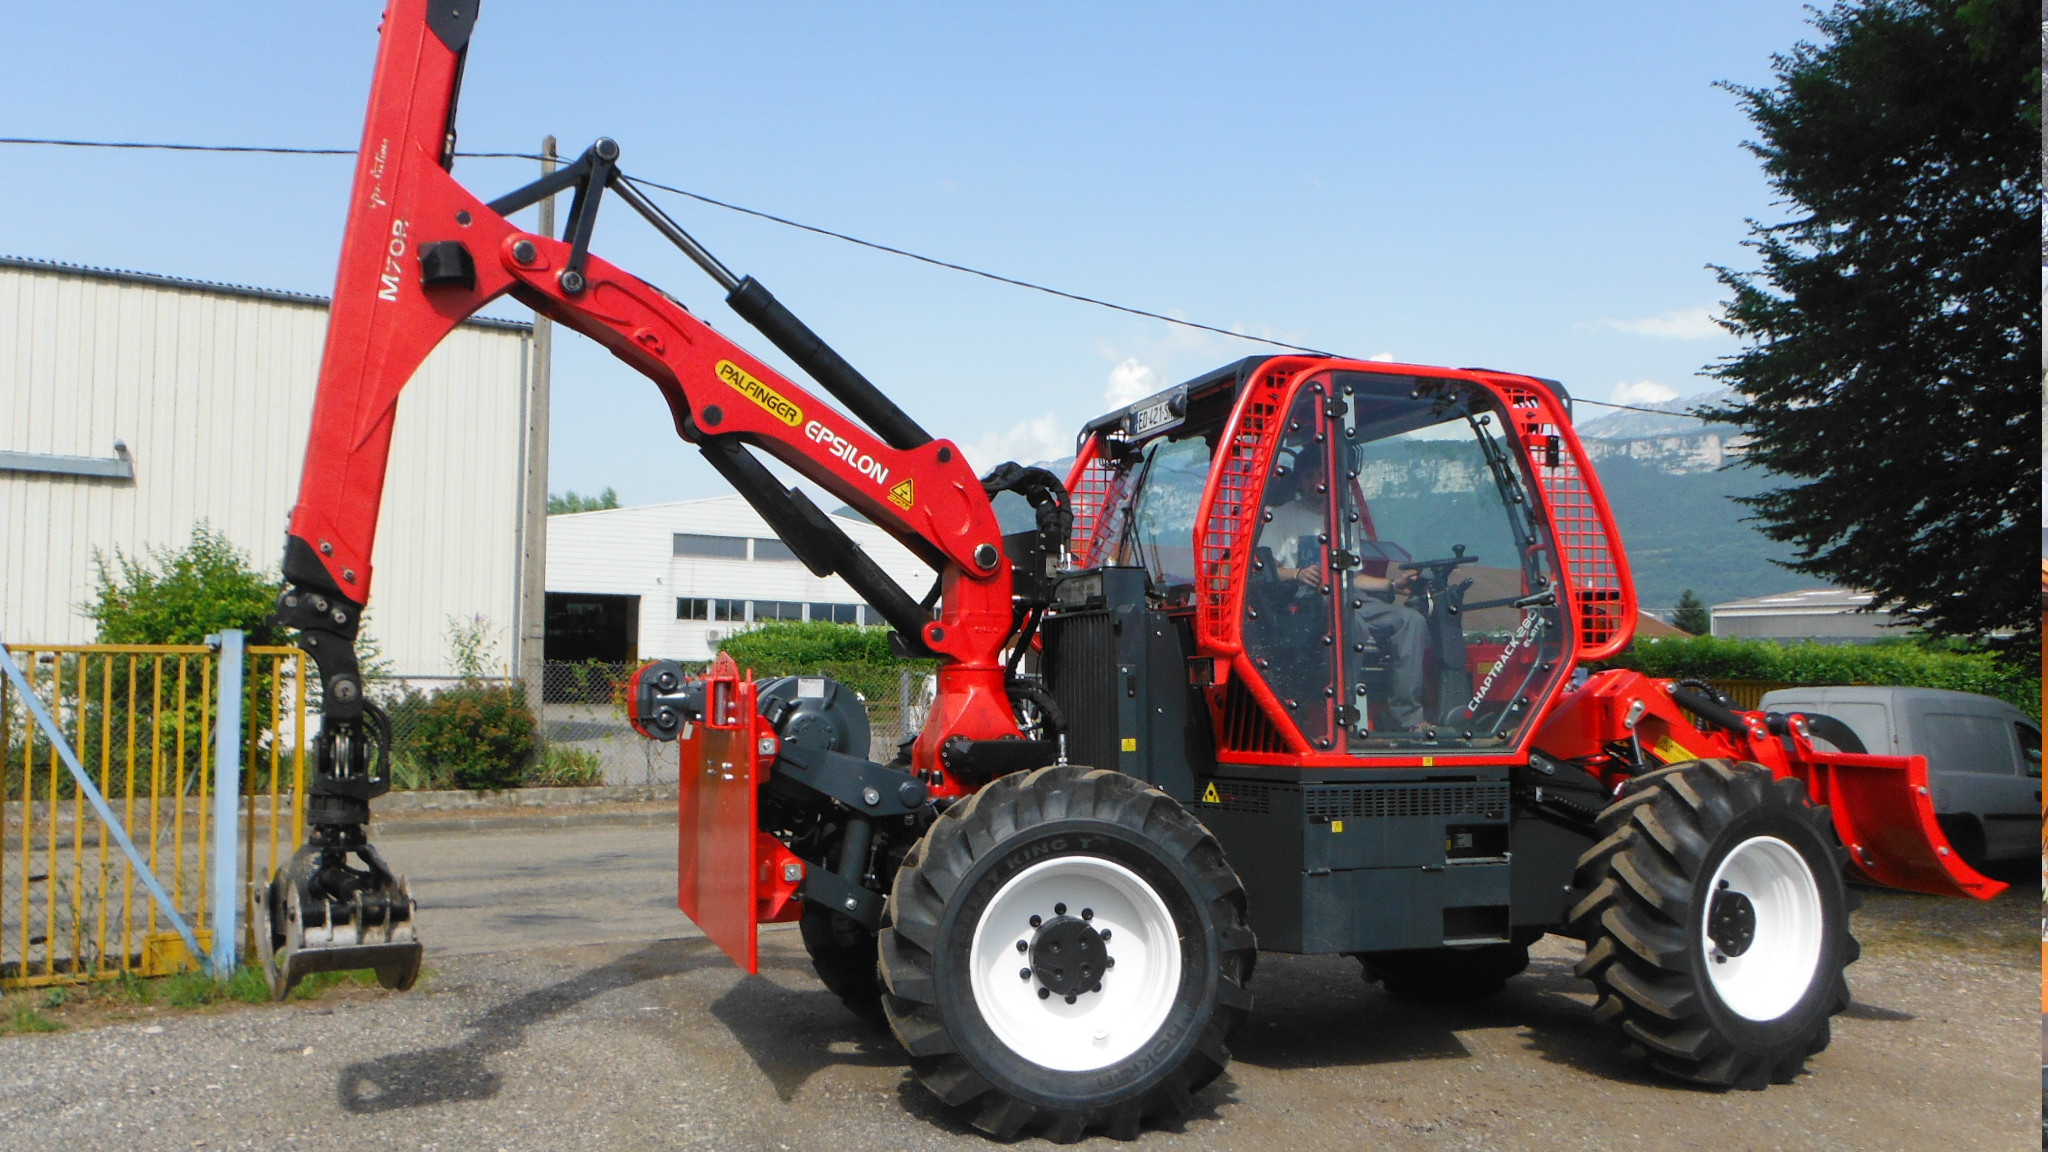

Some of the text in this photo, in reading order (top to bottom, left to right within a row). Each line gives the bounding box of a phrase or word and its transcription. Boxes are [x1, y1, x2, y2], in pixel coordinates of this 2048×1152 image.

[719, 363, 798, 422] PALFINGER
[804, 420, 889, 485] EPSILON
[1467, 635, 1520, 712] CHAPTRACK
